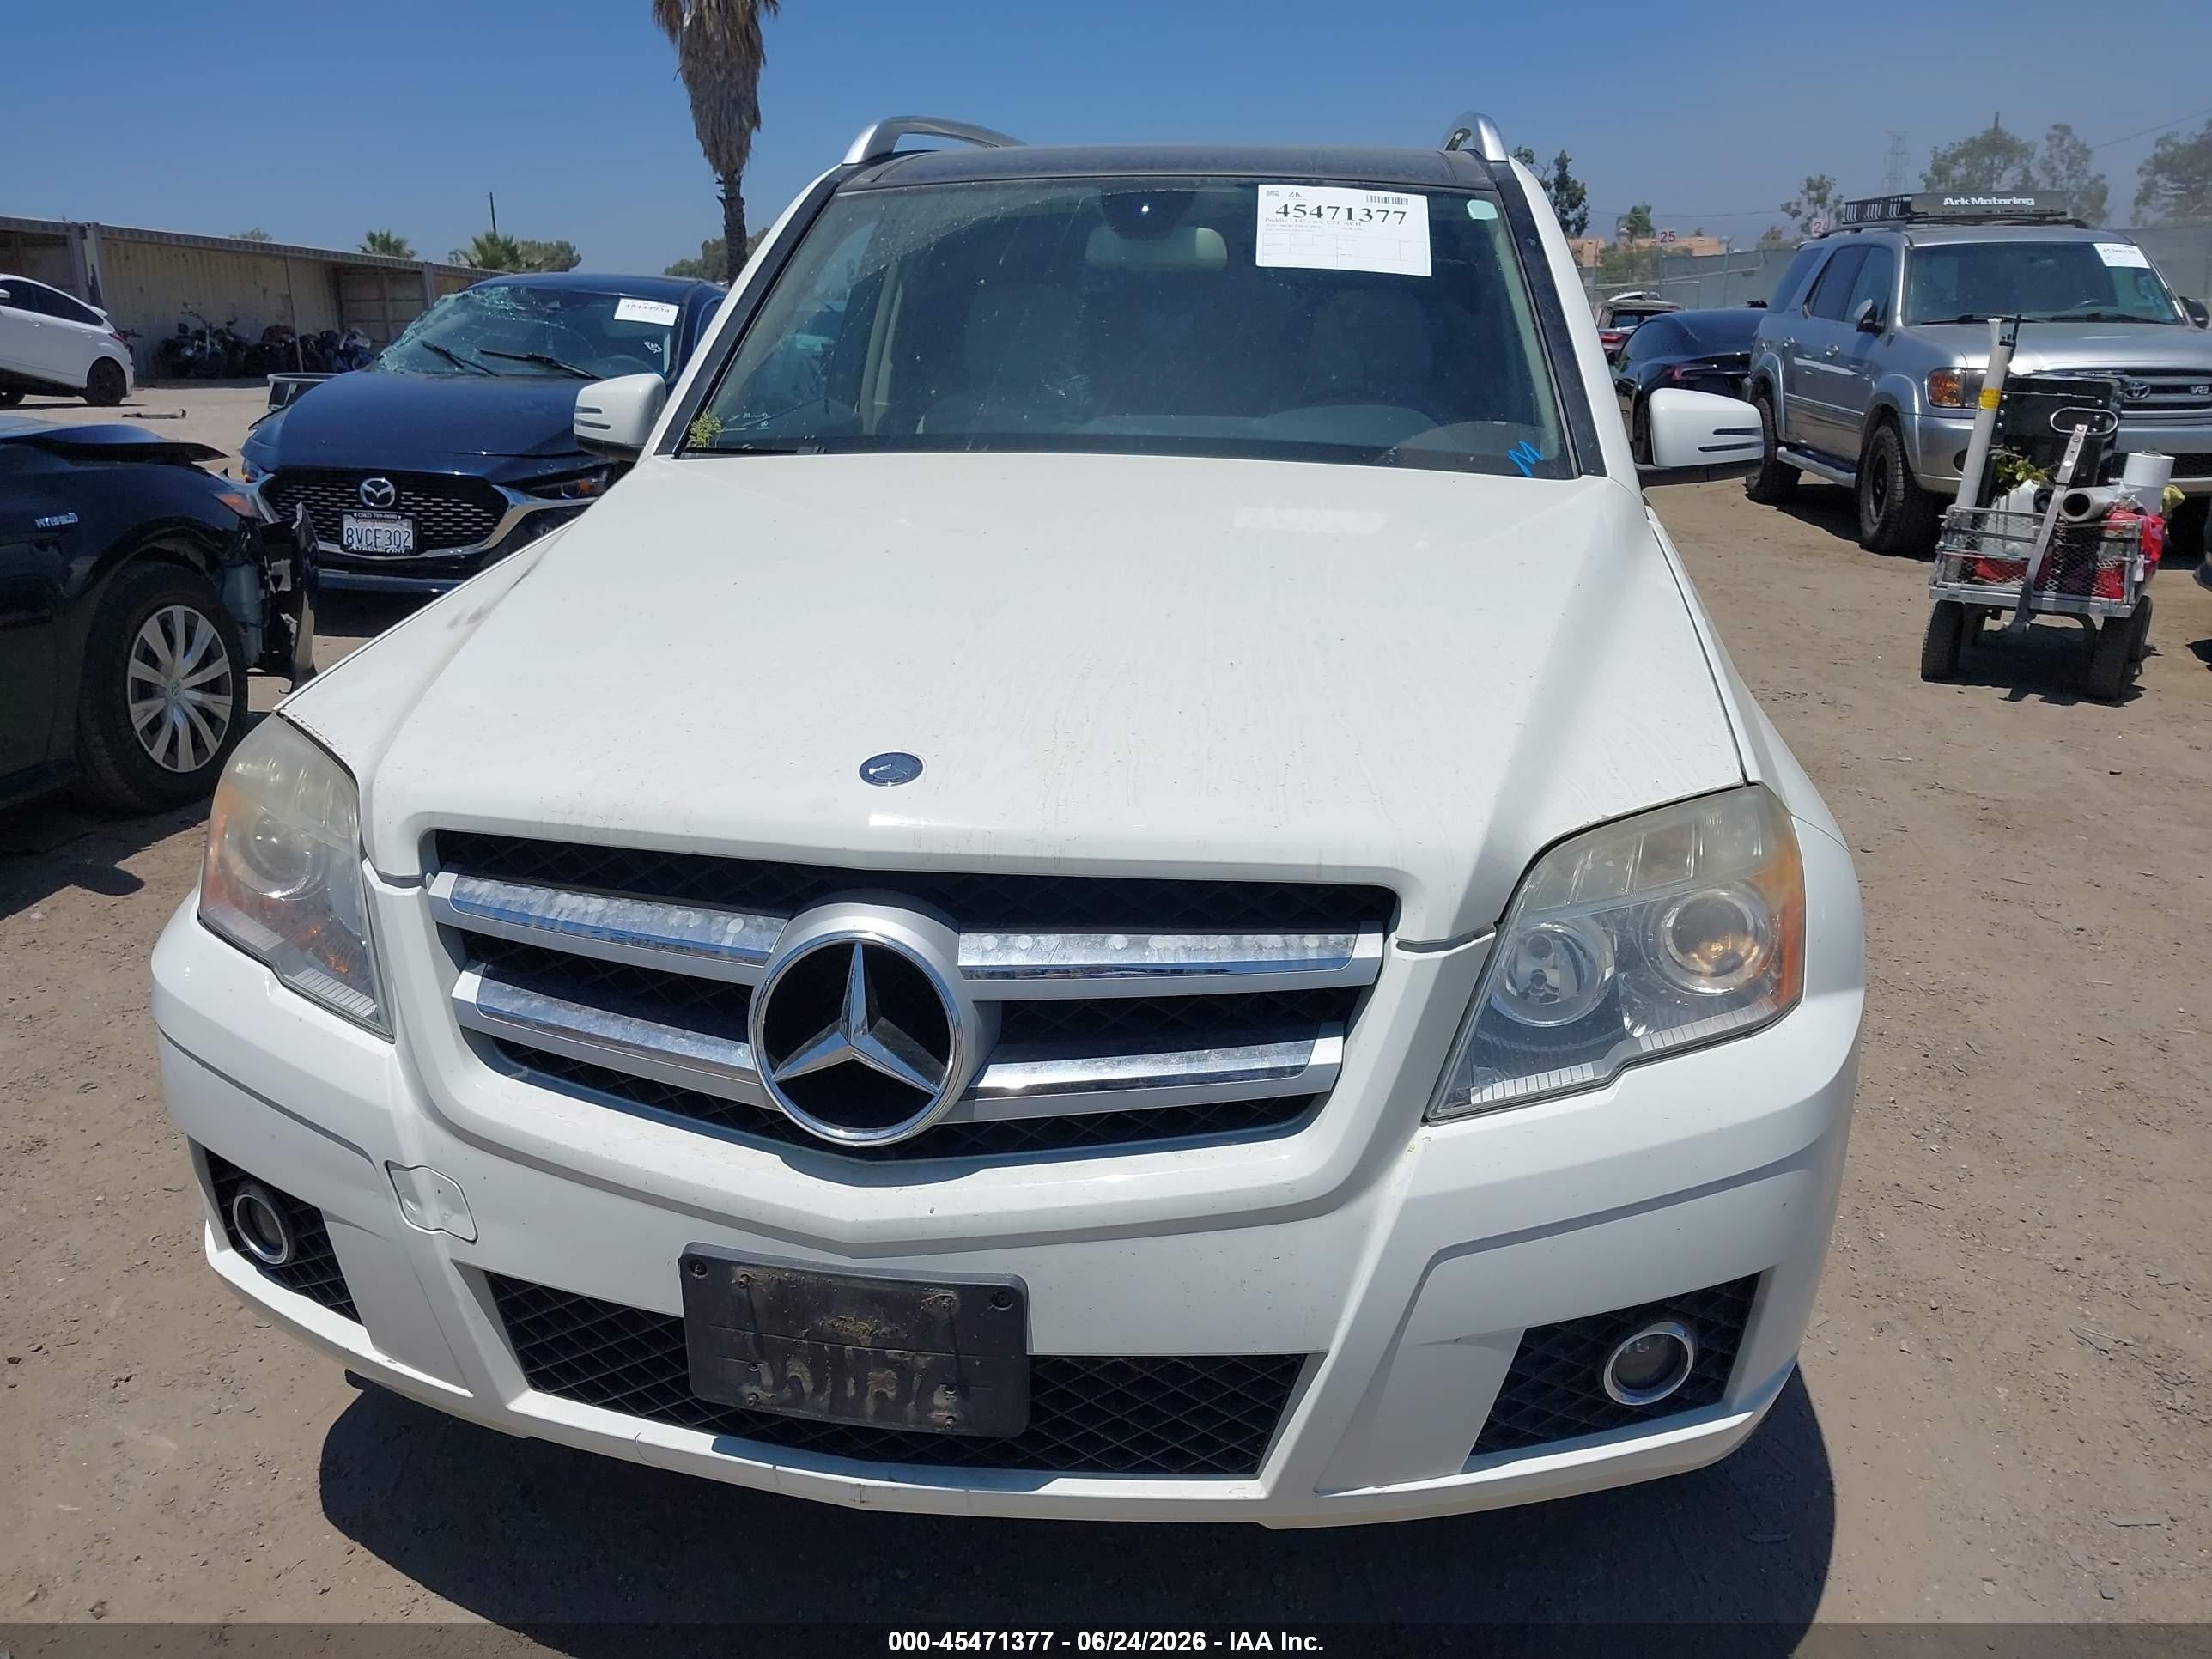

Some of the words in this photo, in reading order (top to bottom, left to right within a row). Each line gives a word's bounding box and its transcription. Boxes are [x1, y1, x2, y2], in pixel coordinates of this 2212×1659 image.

[1943, 198, 1969, 206] Ark
[1971, 198, 2036, 206] Motoring
[1275, 203, 1407, 225] 45471377
[1660, 231, 1676, 243] 25
[2191, 386, 2209, 395] V8
